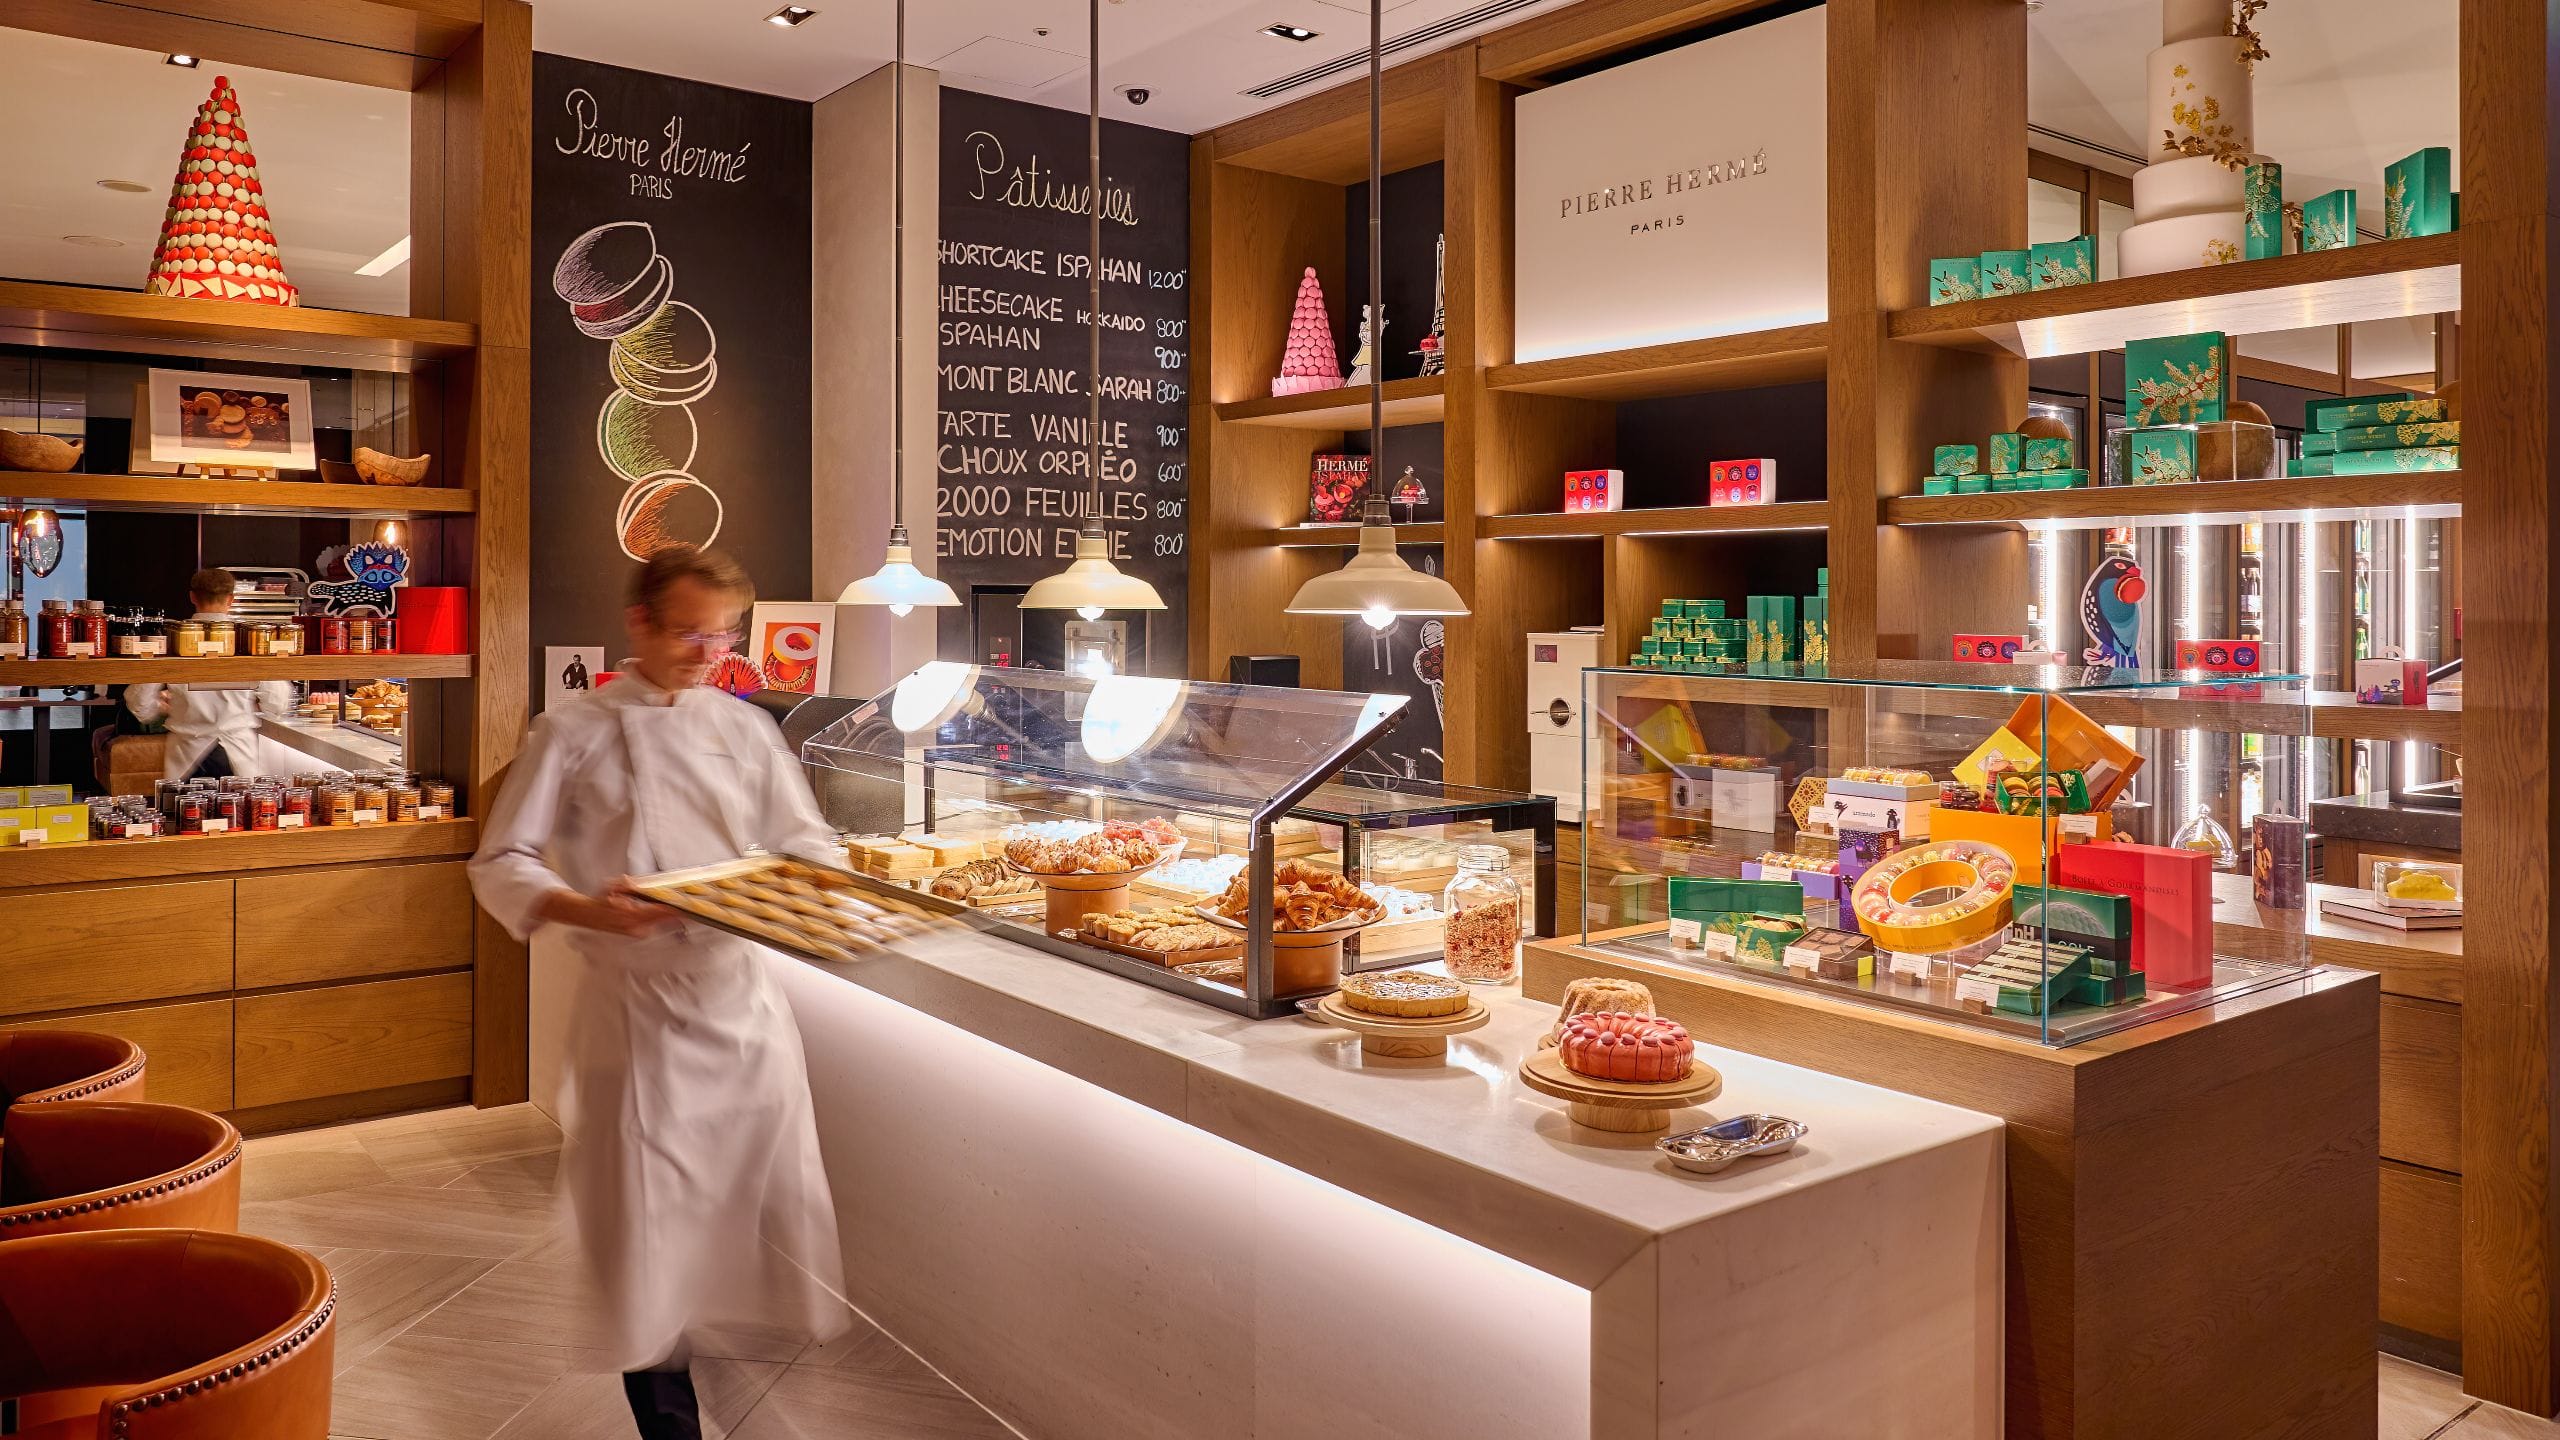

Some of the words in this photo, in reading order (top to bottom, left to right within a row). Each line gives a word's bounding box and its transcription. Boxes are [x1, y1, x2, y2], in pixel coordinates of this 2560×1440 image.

[556, 88, 650, 167] Pierre
[660, 115, 751, 182] Hermé
[629, 173, 673, 200] PARIS
[1560, 179, 1652, 218] PIERRE
[1665, 148, 1767, 195] HERMÉ
[1630, 215, 1685, 235] PARIS
[938, 284, 1064, 322] HEESECAKE
[938, 364, 1002, 392] MONT
[1007, 366, 1078, 394] BLANC
[938, 410, 1012, 438] ARTE
[1030, 413, 1129, 449] VANILE
[938, 444, 1028, 475] CHOUX
[1317, 457, 1368, 471] HERMÉ
[937, 485, 1011, 518] 2000
[1026, 487, 1148, 521] FEUILLES
[937, 527, 1042, 557] EMOTION
[1055, 527, 1133, 560] EIE
